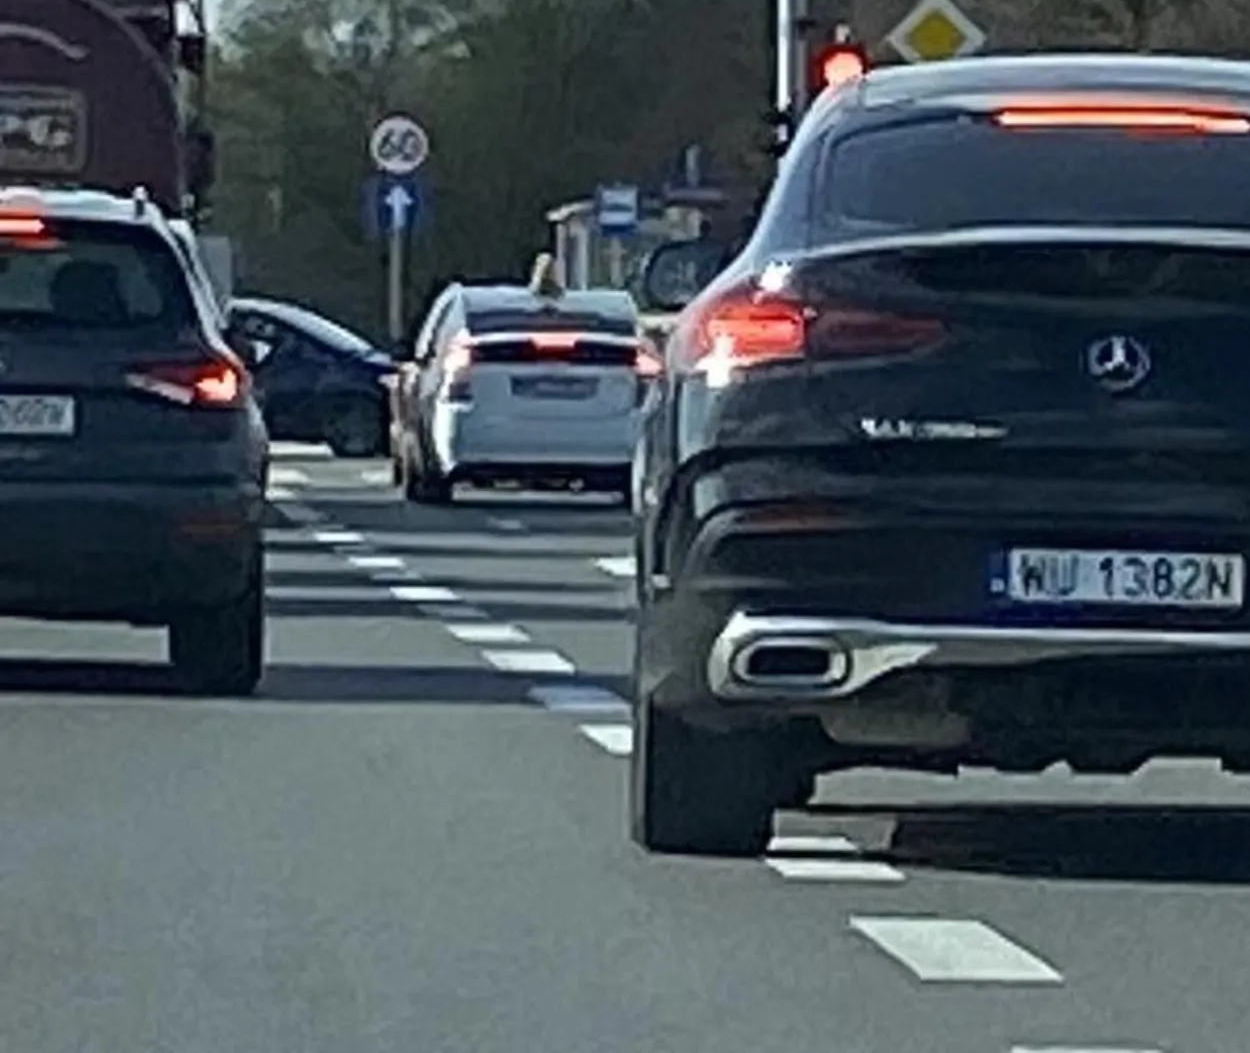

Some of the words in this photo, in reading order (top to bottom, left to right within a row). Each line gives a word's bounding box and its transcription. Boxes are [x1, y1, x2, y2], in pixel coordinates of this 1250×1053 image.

[379, 128, 424, 161] 60
[1020, 553, 1078, 597] WU
[1099, 556, 1234, 600] 1382N
